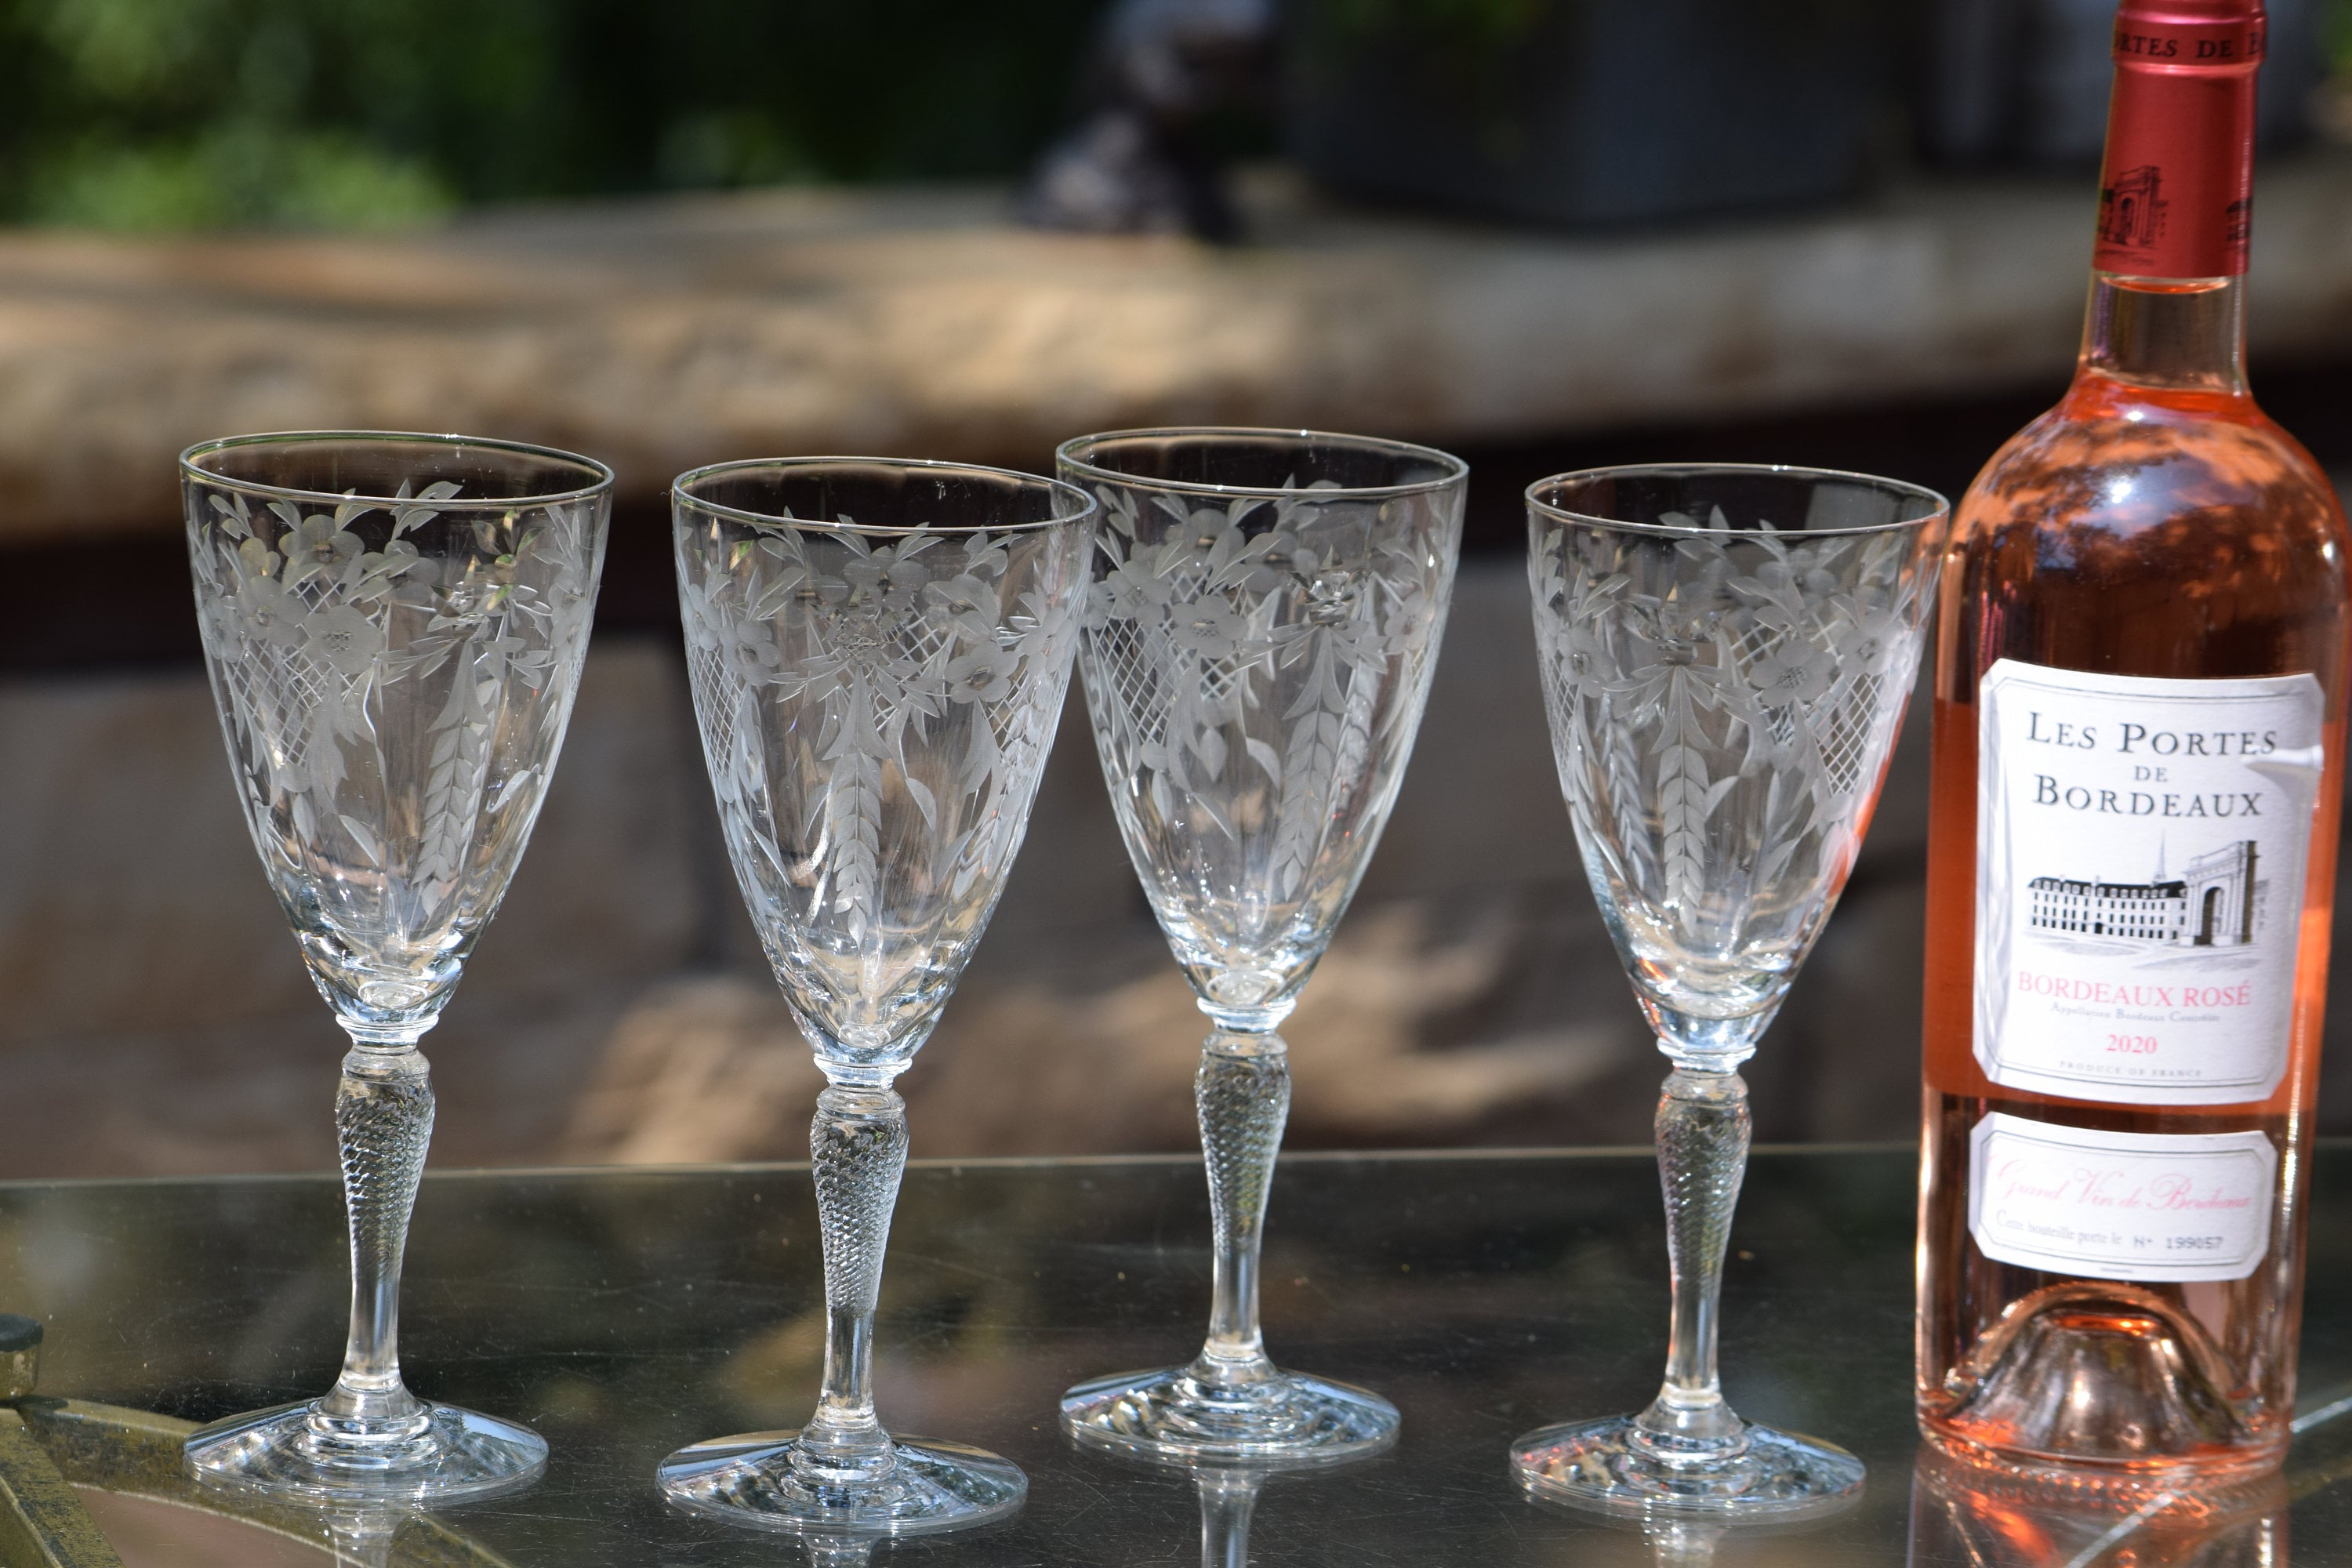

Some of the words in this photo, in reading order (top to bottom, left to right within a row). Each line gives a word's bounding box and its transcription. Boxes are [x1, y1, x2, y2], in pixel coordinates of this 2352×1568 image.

[2114, 33, 2178, 57] RTES
[2196, 39, 2234, 58] DE
[2027, 712, 2096, 750] LES
[2117, 723, 2277, 756] PORTES
[2134, 765, 2168, 782] DE
[2032, 773, 2263, 817] BORDEAUX
[2018, 971, 2175, 1007] BORDEAUX
[2183, 980, 2251, 1007] ROSÉ
[2106, 1034, 2158, 1054] 2020
[2060, 1060, 2122, 1075] PRODUCE
[2129, 1068, 2146, 1076] OF
[2151, 1069, 2202, 1078] FRANCE
[1989, 1156, 2071, 1200] Grand
[2072, 1168, 2124, 1203] Vin
[2119, 1188, 2142, 1209] de
[2165, 1236, 2223, 1250] 199057
